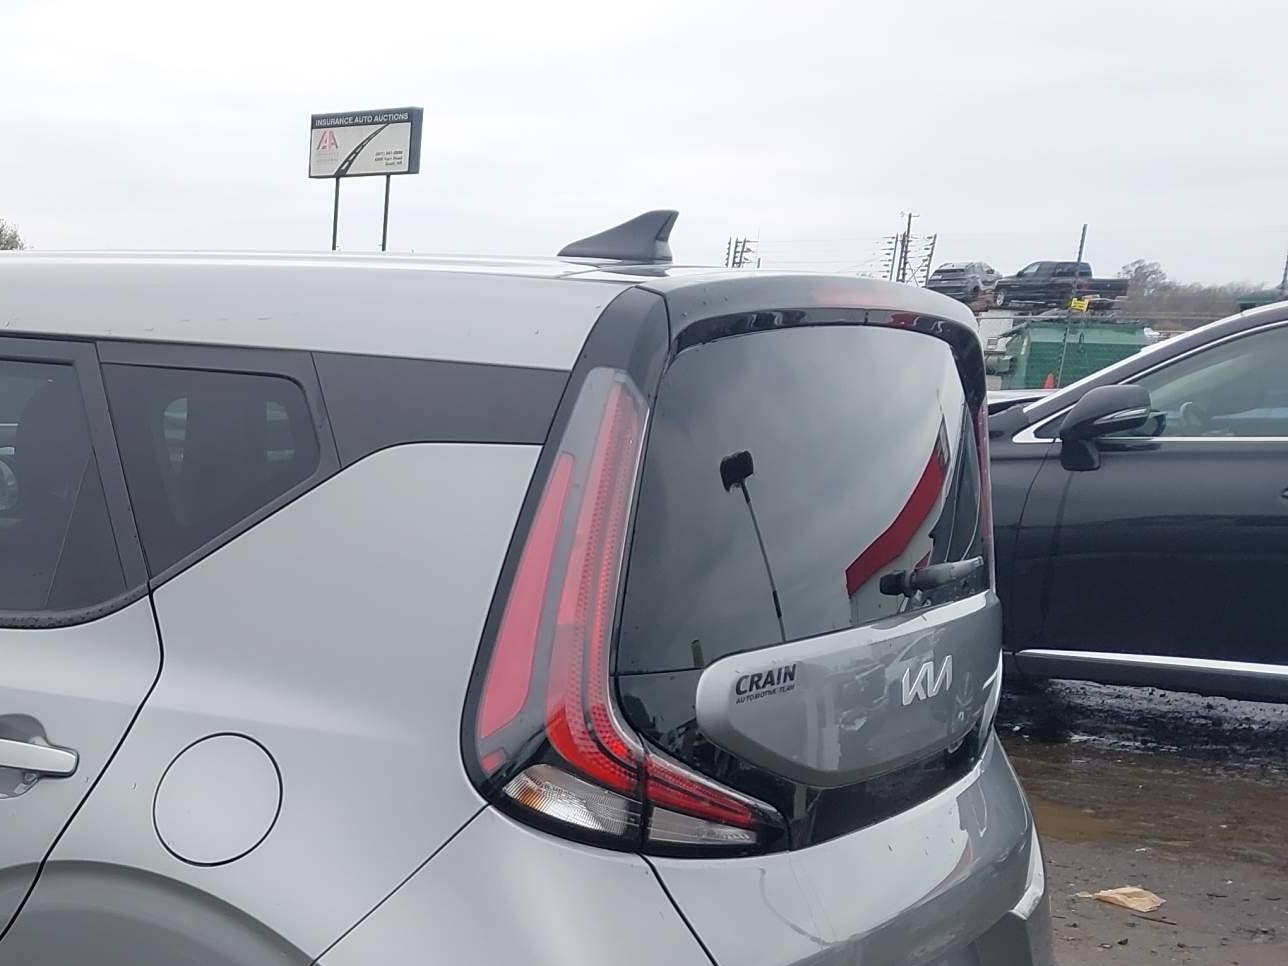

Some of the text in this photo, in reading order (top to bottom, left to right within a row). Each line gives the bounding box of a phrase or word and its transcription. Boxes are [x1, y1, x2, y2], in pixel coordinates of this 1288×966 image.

[315, 112, 409, 127] INSURANCE AUTO AUCTIONS
[735, 663, 797, 696] CRAIN
